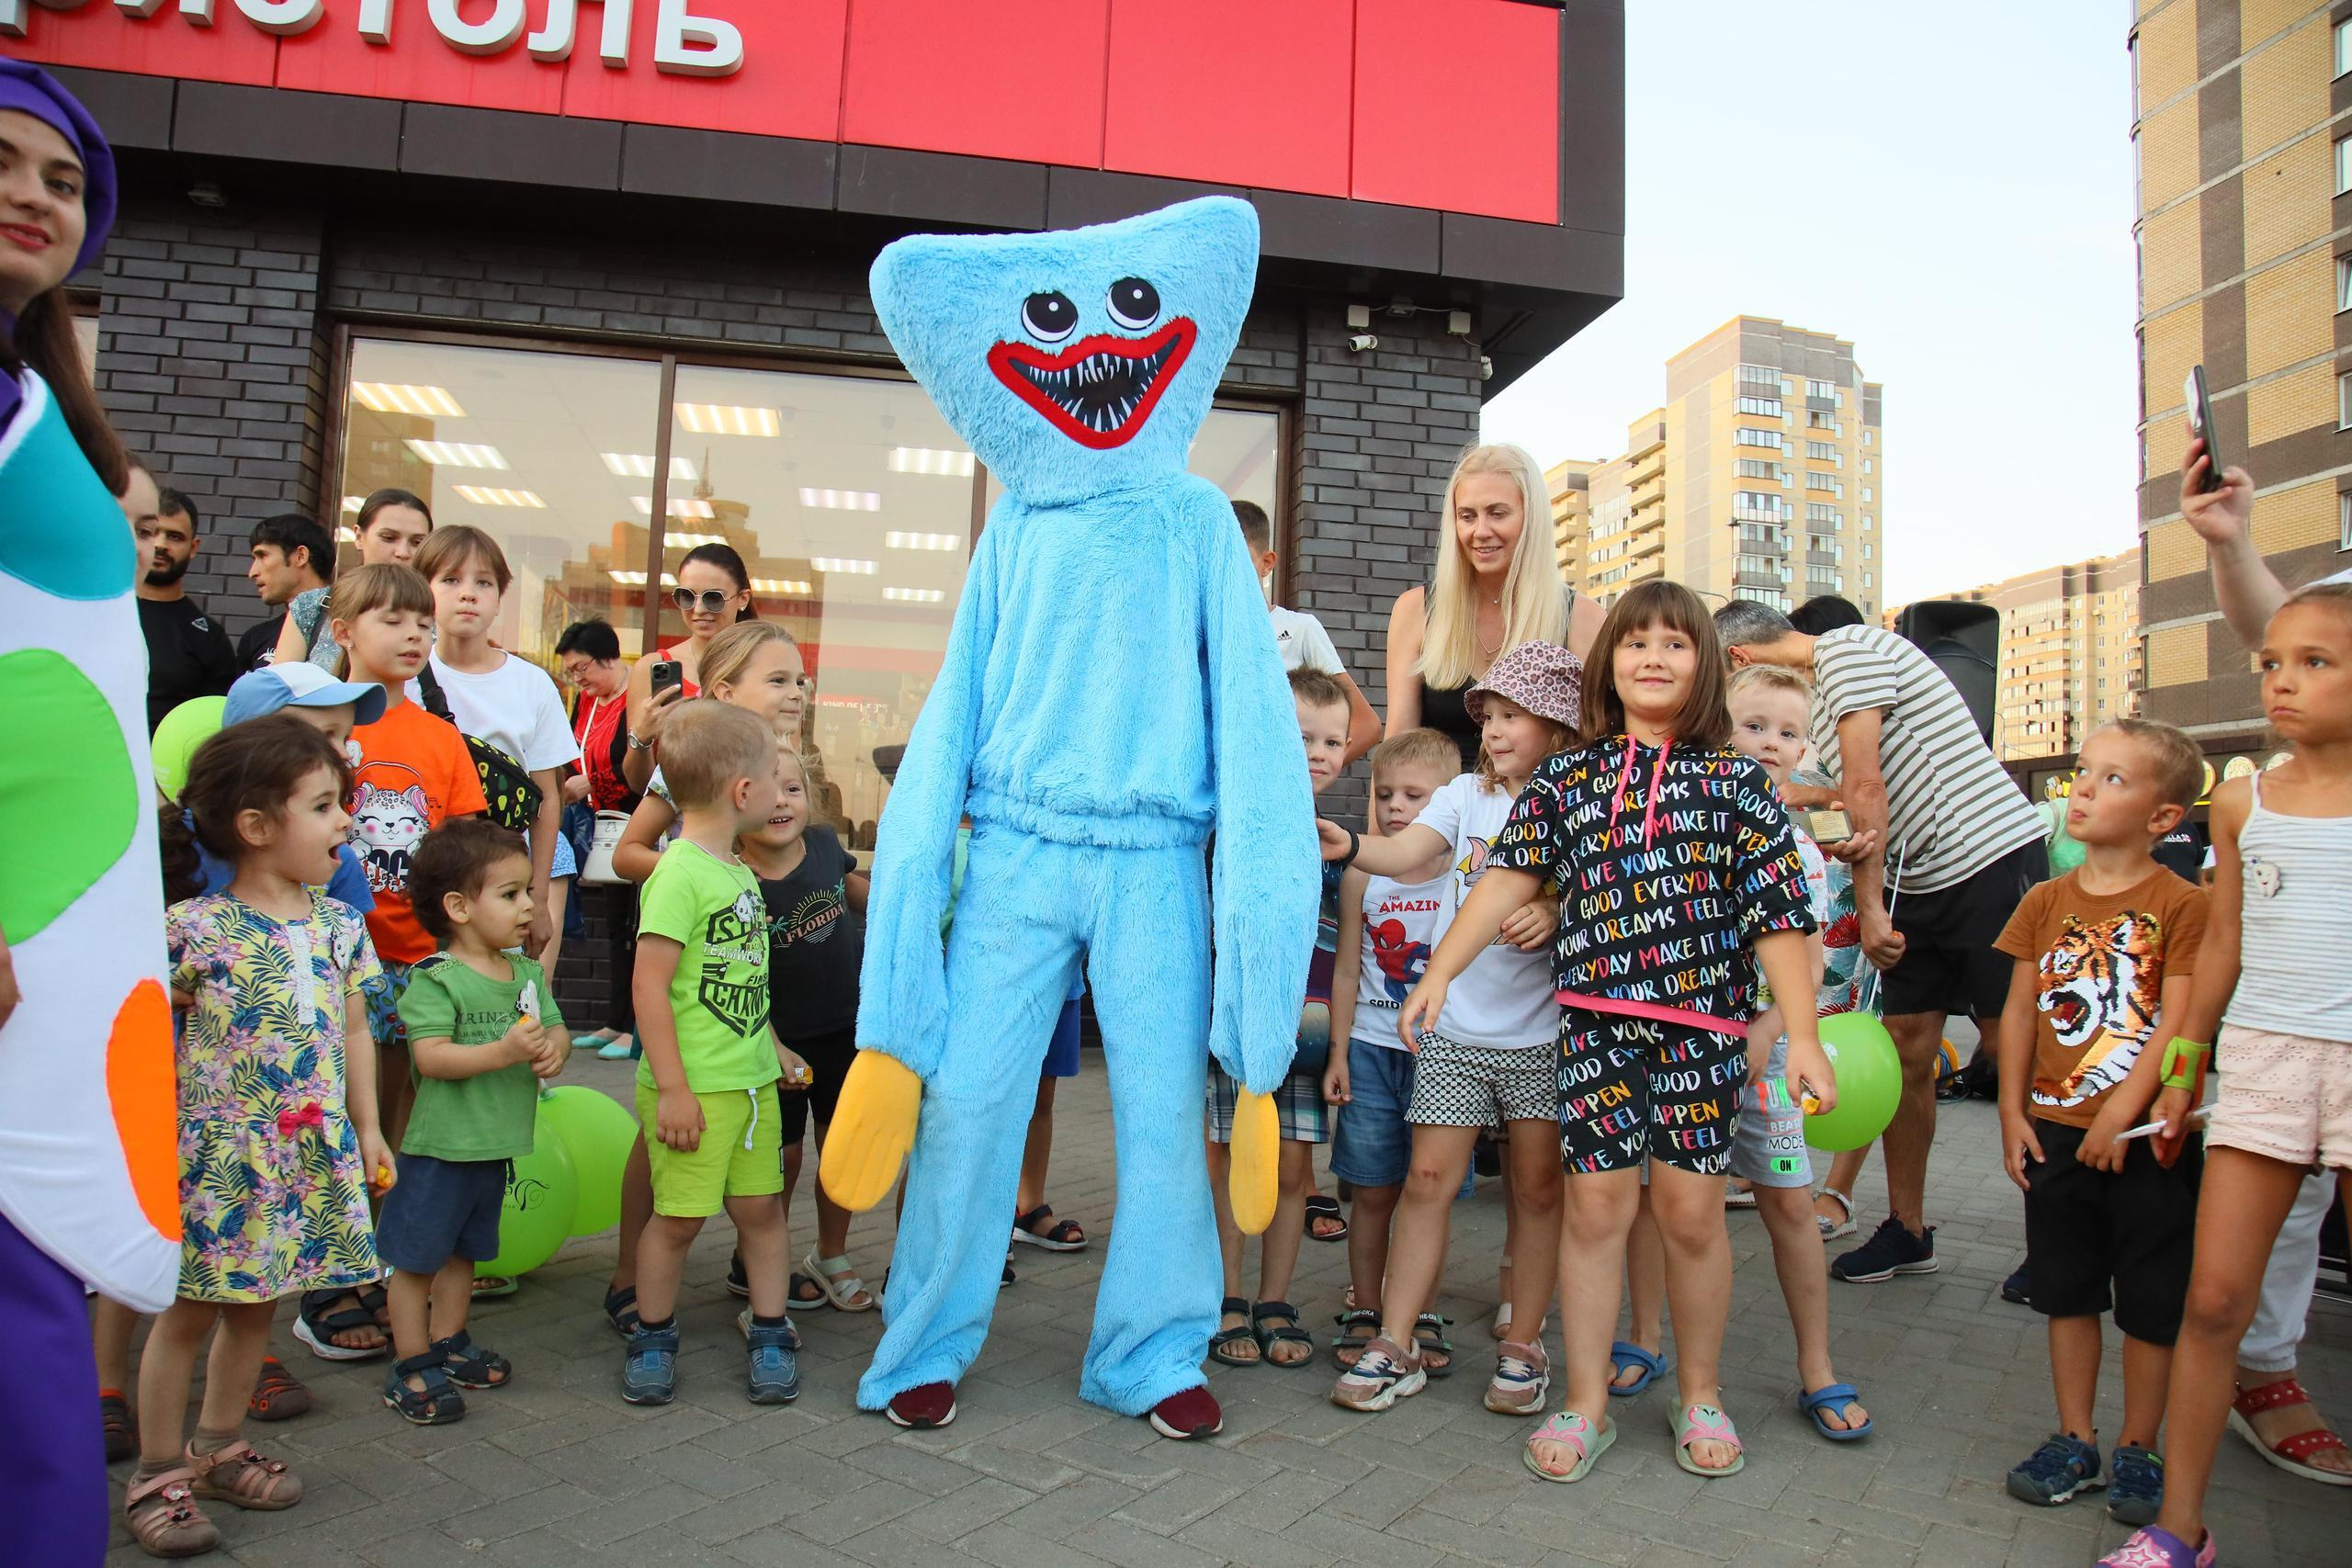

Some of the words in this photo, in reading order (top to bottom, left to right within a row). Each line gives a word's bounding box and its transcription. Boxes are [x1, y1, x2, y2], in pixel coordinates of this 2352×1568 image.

[1510, 795, 1544, 821] LIVE
[1563, 799, 1607, 837] YOUR
[1713, 811, 1730, 834] IT
[1736, 786, 1779, 826] GOOD
[1502, 820, 1549, 846] GOOD
[1579, 860, 1616, 892] LIVE
[1620, 847, 1674, 878] YOUR
[1675, 840, 1735, 867] DREAM
[1579, 887, 1623, 921] GOOD
[786, 903, 844, 943] FLORIDA
[1557, 928, 1591, 962] YOUR
[1594, 905, 1676, 944] DREAMS
[1682, 897, 1724, 923] FEEL
[1638, 936, 1696, 971] MAKE
[1700, 931, 1714, 956] IT
[1664, 959, 1731, 997] DREAMS
[1564, 1029, 1600, 1057] LIVE
[1659, 1037, 1704, 1065] LIVE
[1557, 1056, 1602, 1092] GOOD
[1649, 1069, 1702, 1095] GOOD
[1587, 1106, 1642, 1139] FEEL
[1668, 1126, 1722, 1150] FEEL
[1768, 1134, 1804, 1151] MODE
[1779, 1158, 1792, 1172] ON
